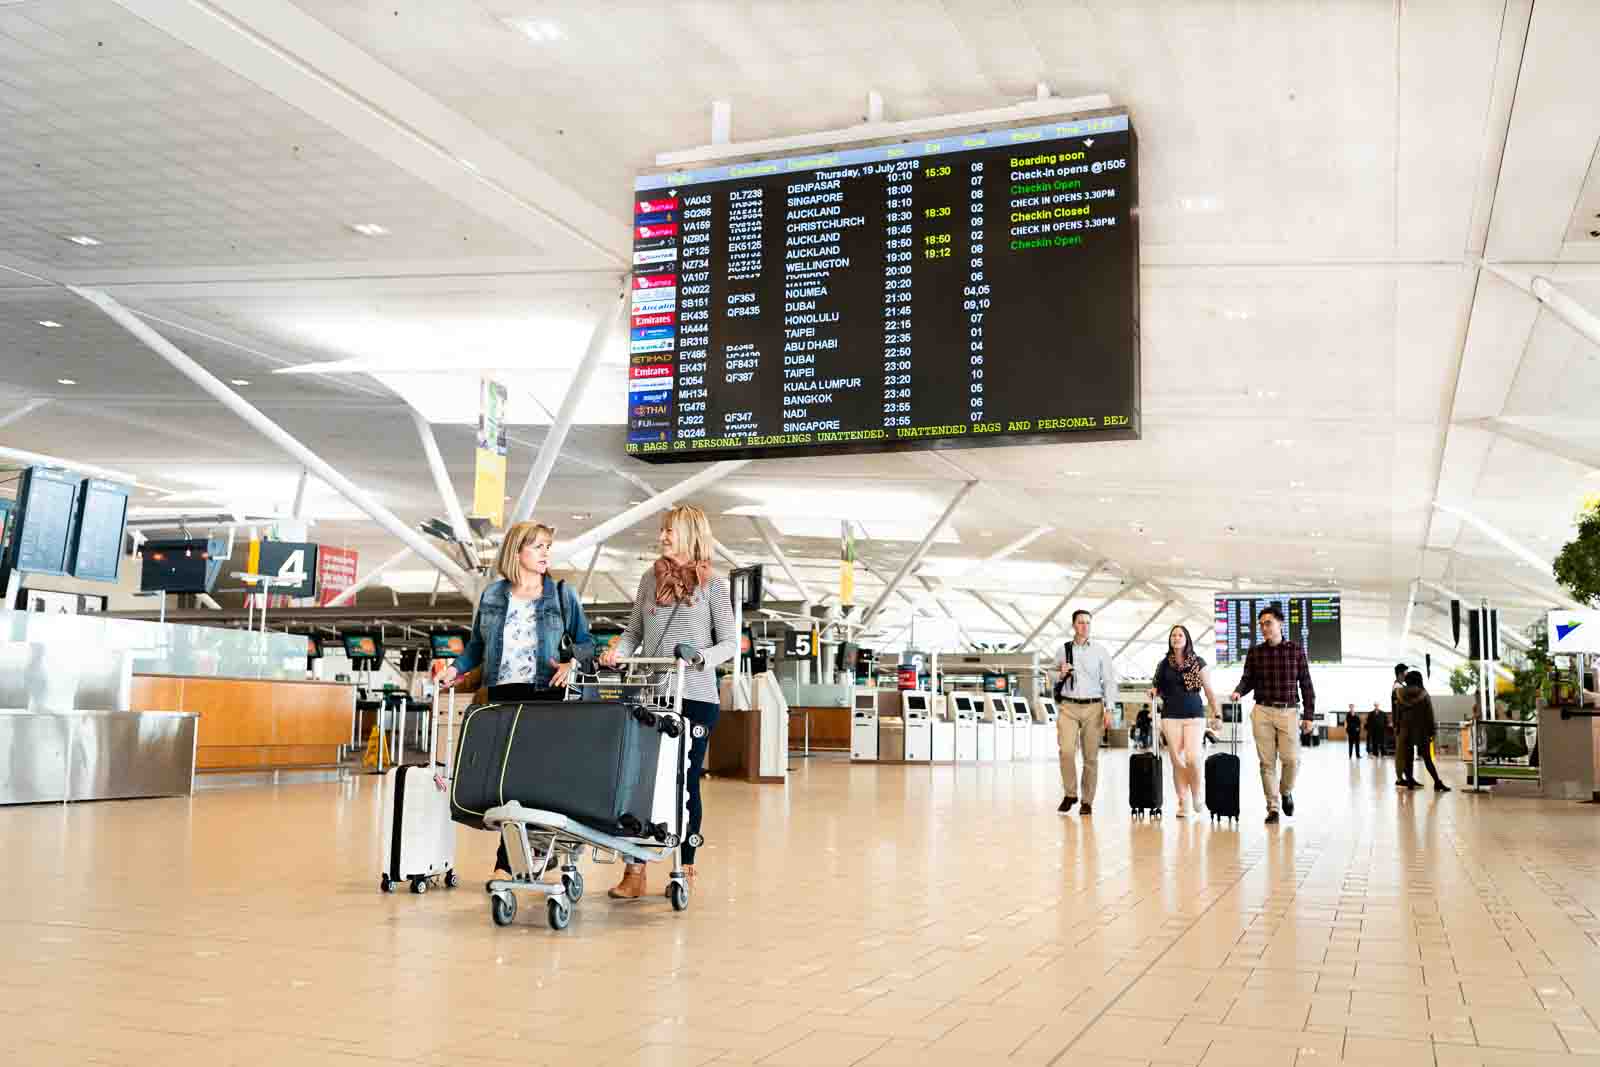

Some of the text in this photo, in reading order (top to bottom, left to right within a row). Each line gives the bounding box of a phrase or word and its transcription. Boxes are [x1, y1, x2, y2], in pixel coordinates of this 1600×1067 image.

[683, 195, 711, 206] VA043
[788, 179, 840, 194] DENPASAR
[887, 171, 912, 182] 10:10
[925, 166, 951, 176] 15:30
[971, 162, 983, 172] 08
[1011, 155, 1056, 167] Boarding
[1059, 152, 1084, 161] soon
[788, 192, 843, 206] SINGAPORE
[886, 184, 912, 195] 18:00
[971, 176, 983, 185] 07
[1011, 168, 1054, 180] Check-in
[1057, 165, 1088, 176] opens
[1091, 159, 1126, 173] @1505
[815, 160, 919, 180] Thursday, 19 July 2018
[787, 206, 840, 220] AUCKLAND
[887, 198, 912, 208] 18:10
[971, 190, 983, 199] 08
[1010, 182, 1052, 195] Checkin
[1055, 180, 1080, 191] Open
[787, 216, 864, 232] CHRISTCHURCH
[887, 211, 912, 222] 18:30
[925, 207, 950, 217] 18:30
[971, 203, 983, 212] 02
[1011, 197, 1039, 207] CHECK
[1042, 196, 1049, 204] IN
[1052, 192, 1082, 203] OPENS
[1084, 188, 1115, 199] 3.30PM
[682, 217, 1115, 269] NZ734 AUCKLAND 18:50 18:50 02 CHECK IN OPENS 3.30PM
[683, 205, 1089, 257] QF125 EK5125 AUCKLAND 18:45 09 Checkin Closed
[682, 236, 1081, 282] VA107 WELLINGTON 19:00 19:12 08 Checkin Open
[681, 297, 708, 308] SB151
[785, 286, 827, 298] NOUMEA
[885, 278, 912, 289] 20:20
[971, 271, 983, 281] 06
[682, 258, 983, 295] ON022 20:00 05
[680, 323, 708, 334] HA444
[785, 312, 839, 325] HONOLULU
[885, 306, 911, 316] 21:45
[964, 299, 990, 310] 09,10
[681, 285, 990, 321] EK435 QF8435 DUBAI 21:00 04,05
[636, 315, 671, 326] Emirates
[680, 313, 983, 347] BR316 TAIPEI 22:15 07
[784, 341, 805, 352] ABU
[807, 339, 837, 350] DHABI
[885, 333, 911, 343] 22:35
[971, 327, 982, 336] 01
[634, 367, 669, 378] Emirates
[679, 376, 703, 386] CI054
[784, 368, 814, 378] TAIPEI
[885, 361, 911, 371] 23:00
[971, 355, 983, 365] 06
[680, 341, 983, 373] EK431 QF8431 DUBAI 22:50 04
[679, 388, 707, 399] MH134
[784, 381, 817, 391] KUALA
[819, 378, 861, 389] LUMPUR
[884, 374, 911, 385] 23:20
[971, 369, 983, 379] 10
[784, 394, 832, 405] BANGKOK
[884, 388, 911, 398] 23:40
[971, 383, 983, 393] 05
[647, 405, 666, 415] THAI
[677, 411, 983, 438] SQ246 SINGAPORE 23:55 07
[678, 415, 704, 425] FJ922
[724, 412, 752, 422] QF347
[784, 409, 806, 418] NADI
[884, 402, 910, 412] 23:55
[971, 397, 983, 407] 06
[643, 441, 668, 451] BAGS
[673, 441, 686, 449] OR
[692, 437, 742, 448] PERSONAL
[747, 434, 811, 445] BELONGINGS
[817, 430, 888, 441] UNATTENDED.
[897, 425, 966, 437] UNATTENDED
[973, 423, 1000, 432] BAGS
[1008, 421, 1030, 430] AND
[1038, 417, 1096, 429] PERSONAL
[278, 549, 307, 588] 4
[795, 634, 811, 656] 5
